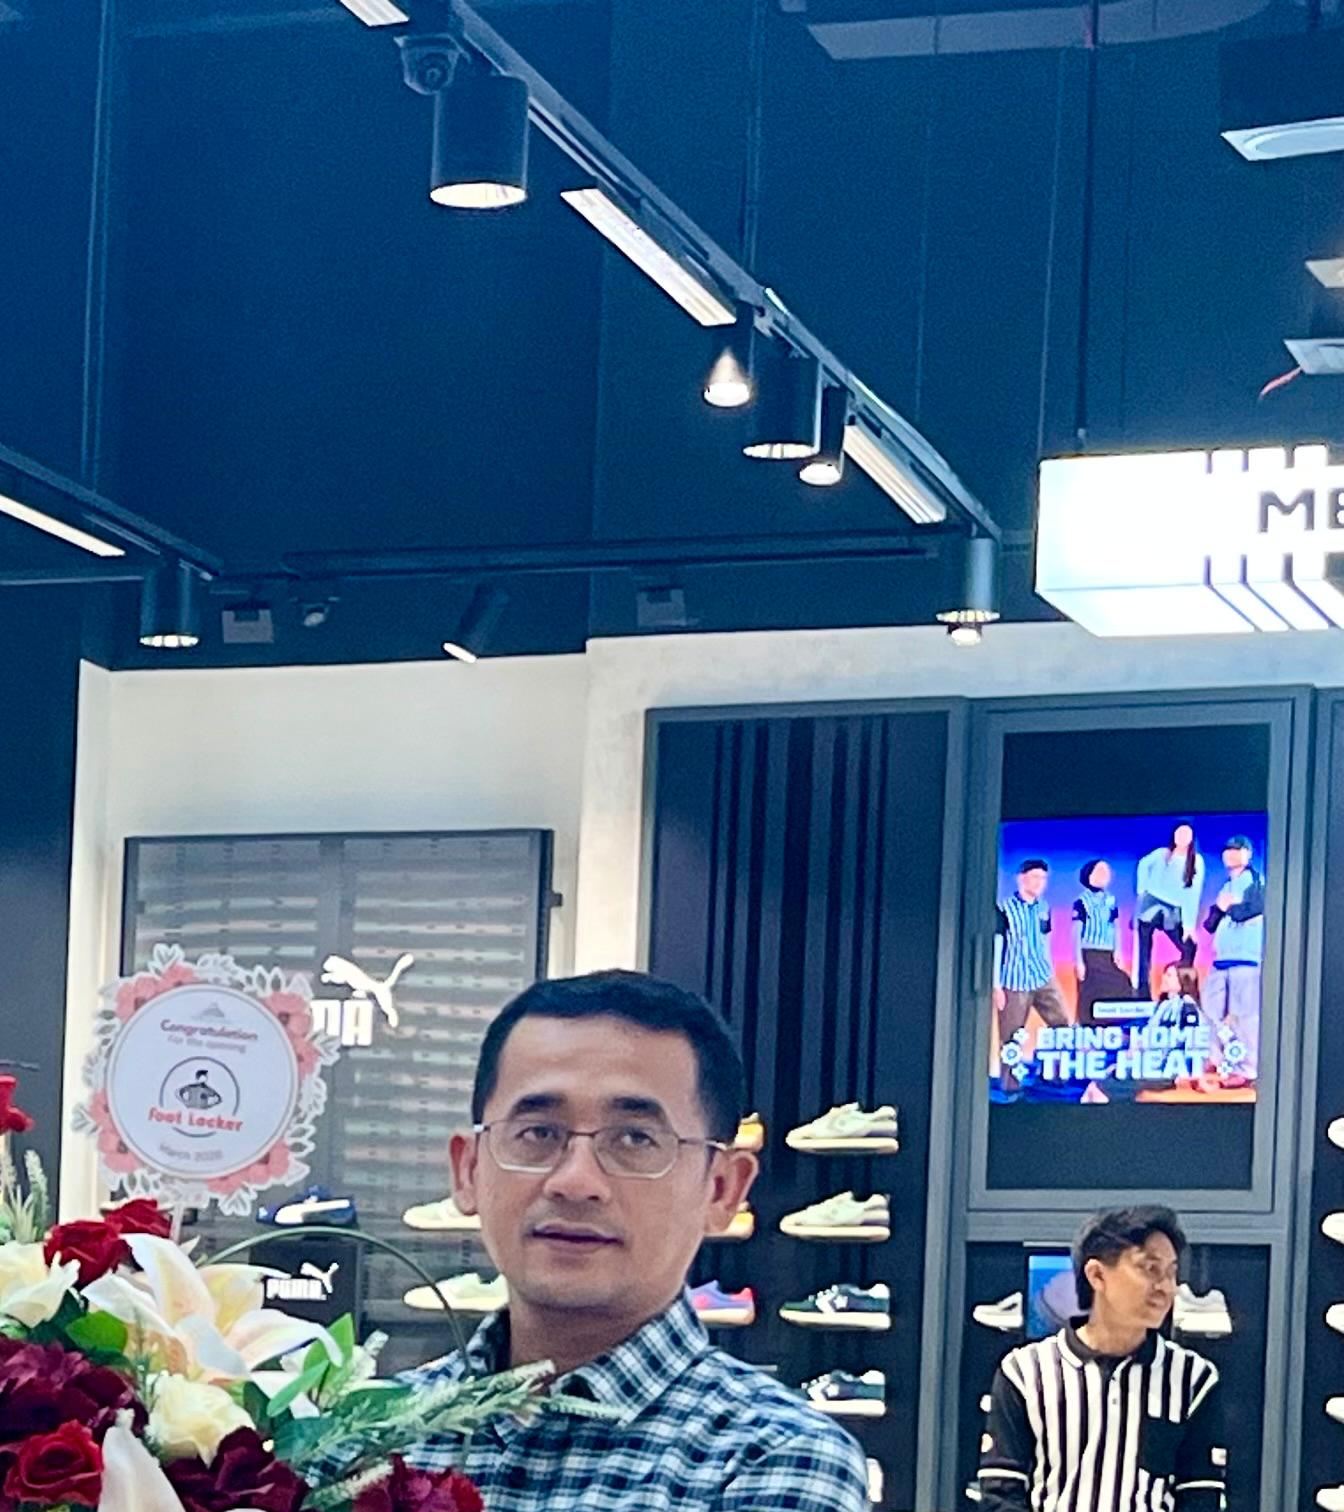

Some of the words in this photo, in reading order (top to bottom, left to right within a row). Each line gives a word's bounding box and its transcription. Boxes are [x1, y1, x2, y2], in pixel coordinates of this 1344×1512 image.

[1035, 1025, 1124, 1050] BRING
[1129, 1024, 1213, 1050] HOME
[1035, 1051, 1108, 1080] THE
[1115, 1049, 1210, 1080] HEAT
